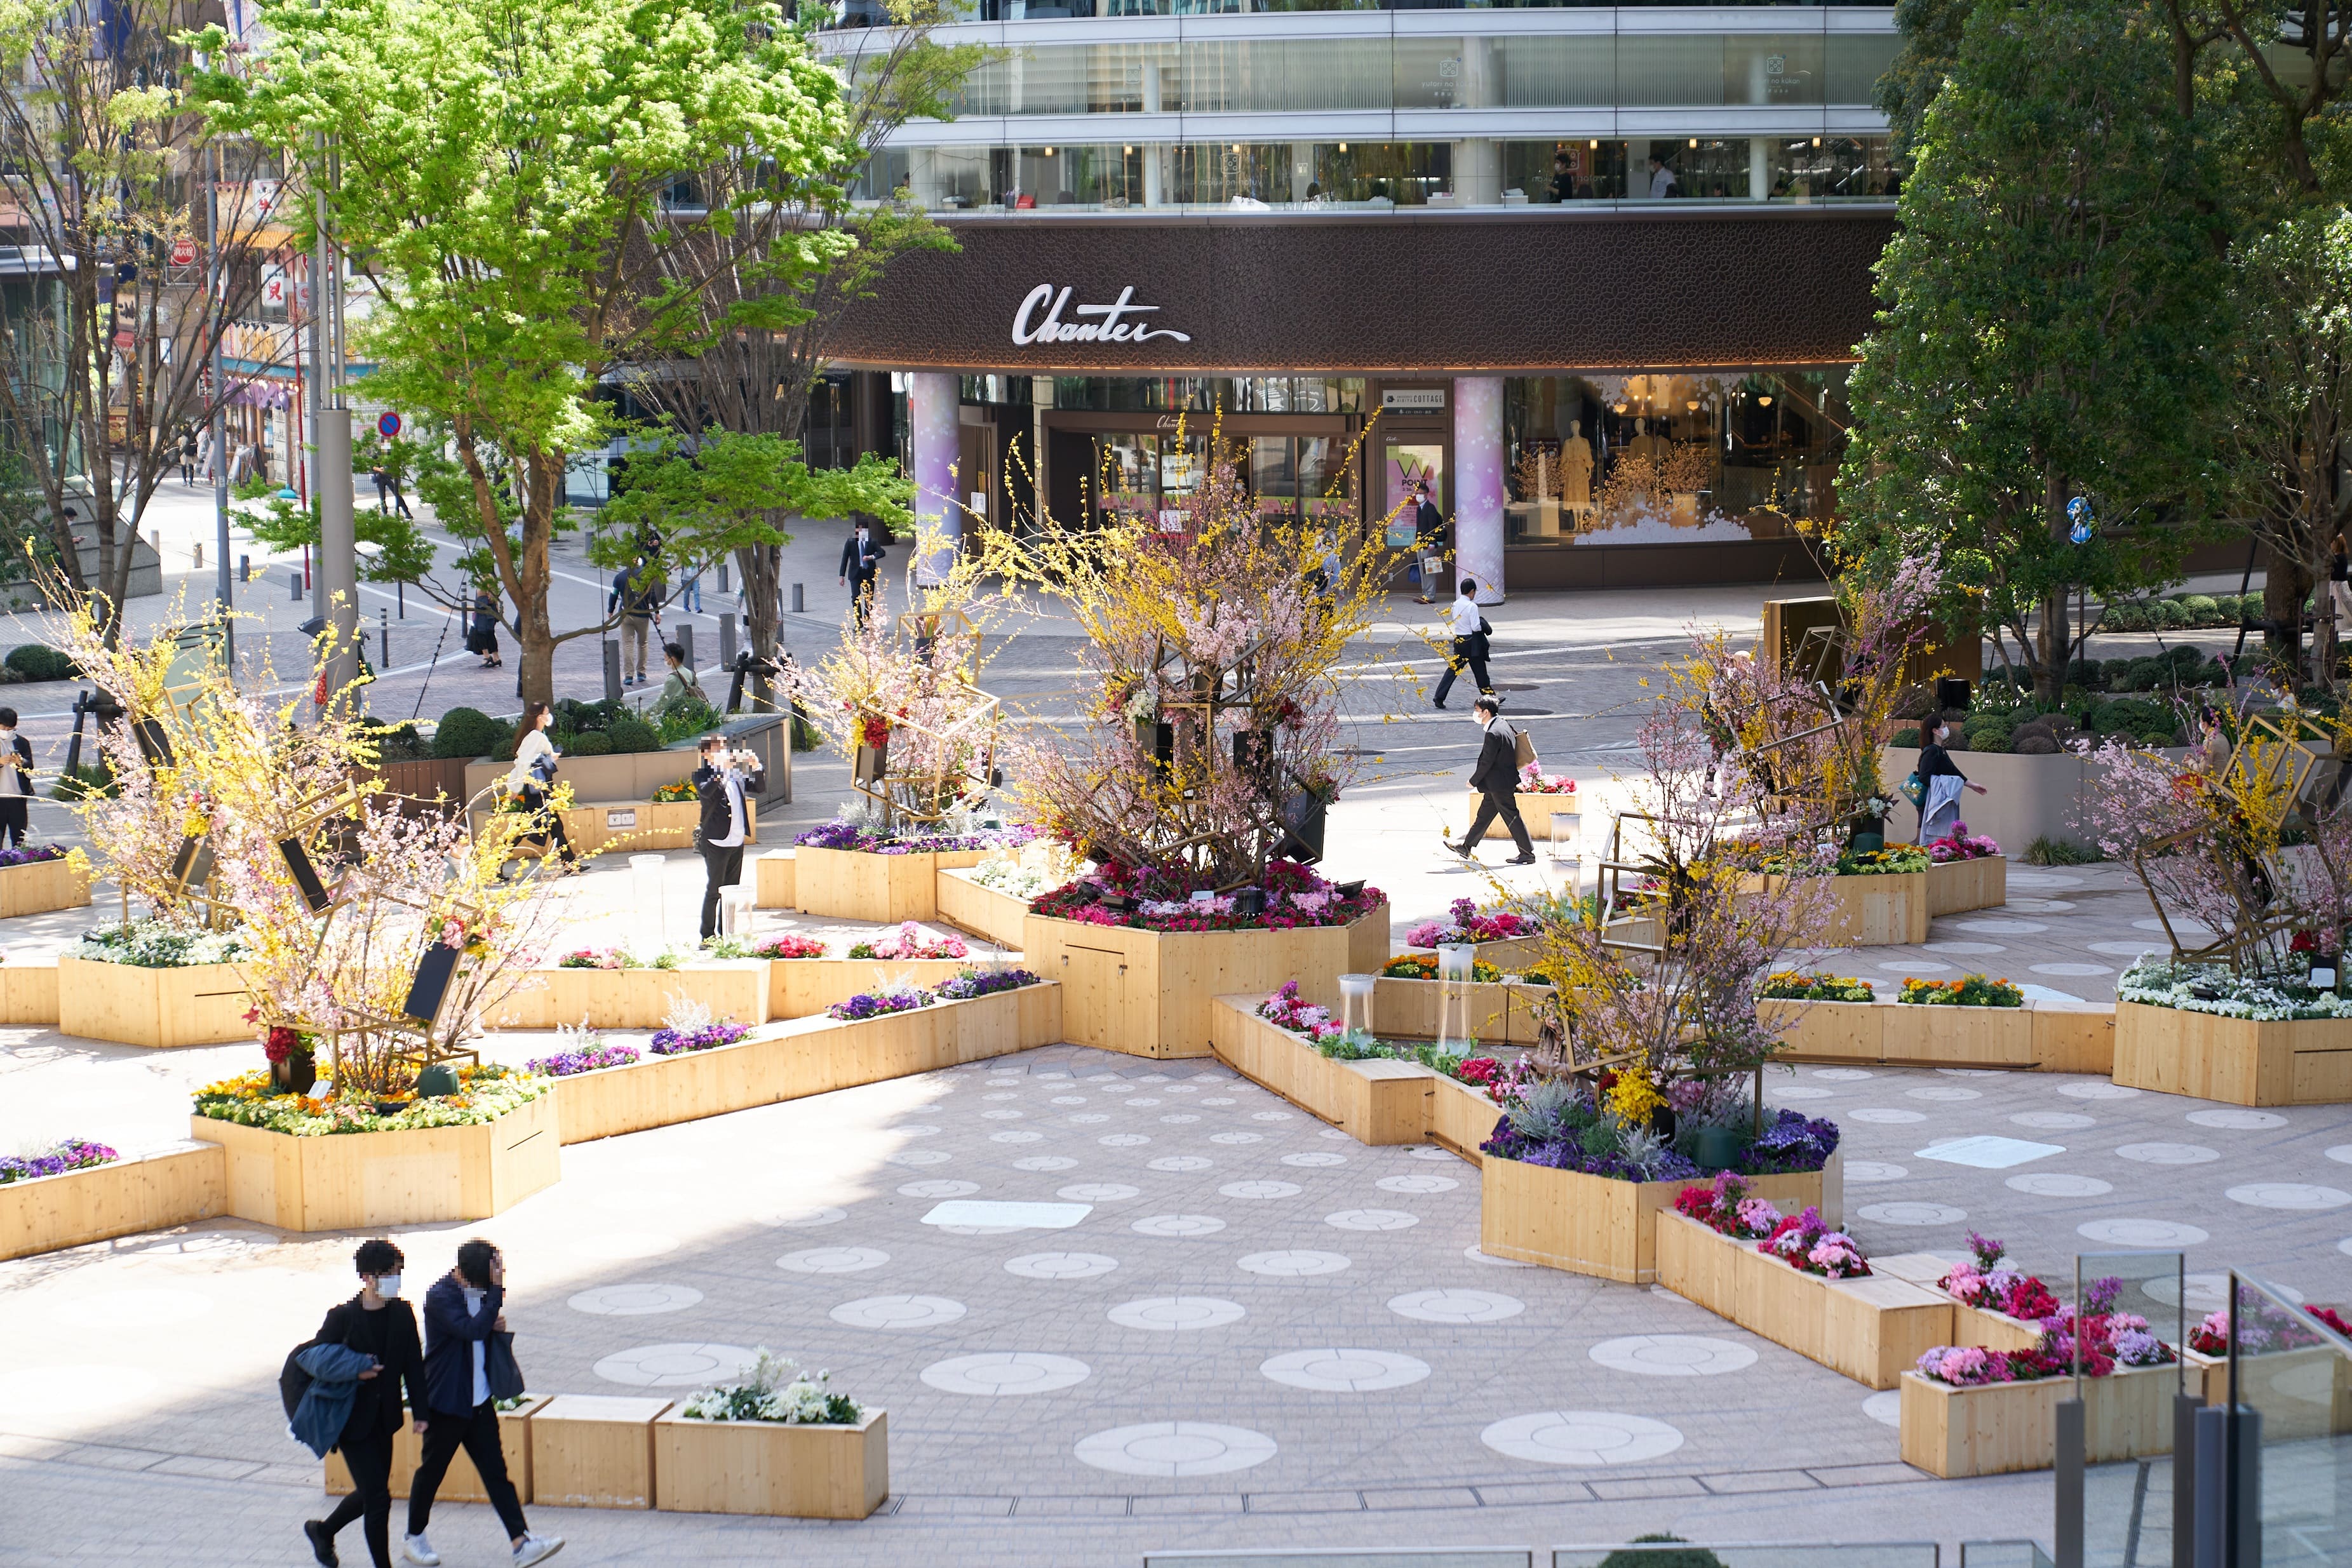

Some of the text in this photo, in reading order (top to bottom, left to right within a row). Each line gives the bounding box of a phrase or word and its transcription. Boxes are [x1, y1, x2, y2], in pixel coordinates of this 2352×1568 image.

[173, 246, 194, 257] 消火栓
[1011, 283, 1191, 345] Chanter
[1413, 394, 1442, 403] COTTAGE
[1397, 459, 1432, 478] W
[1278, 499, 1294, 509] W
[1325, 500, 1341, 511] W
